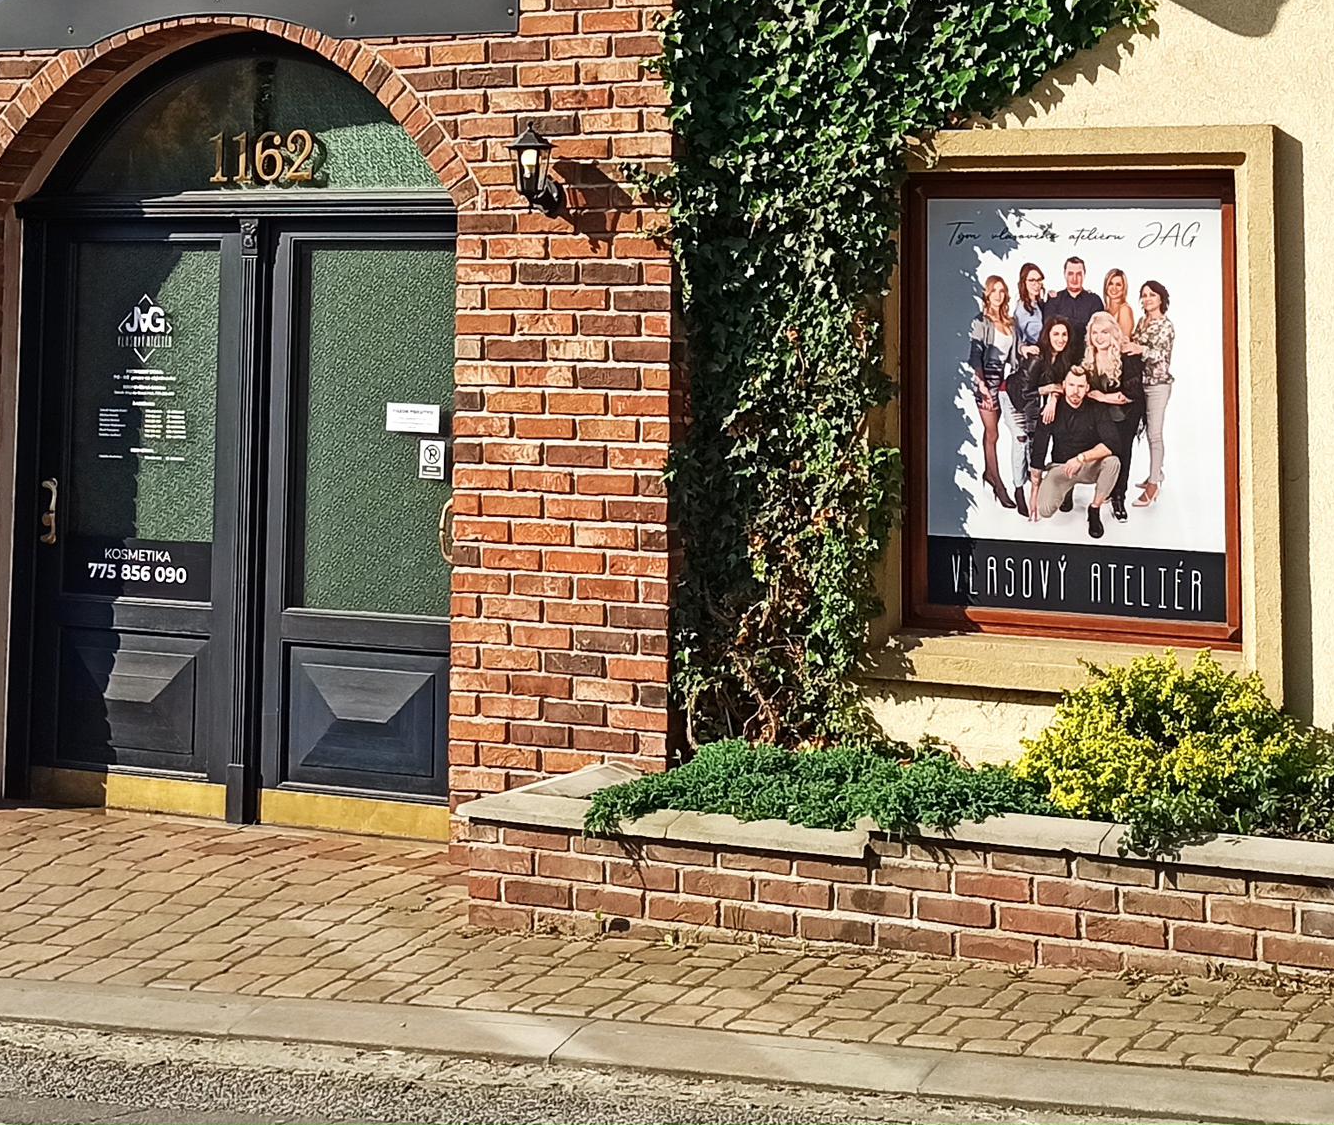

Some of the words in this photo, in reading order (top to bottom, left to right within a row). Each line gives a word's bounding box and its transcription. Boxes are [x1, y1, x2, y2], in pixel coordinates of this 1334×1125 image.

[208, 129, 314, 183] 1162
[1137, 222, 1201, 249] JAG
[104, 548, 171, 563] KOSMETIKA
[88, 562, 117, 579] 775
[121, 563, 151, 582] 856
[154, 566, 187, 584] 090
[951, 554, 1067, 601] VLASOVÝ
[1090, 560, 1203, 612] ATELIÉR
